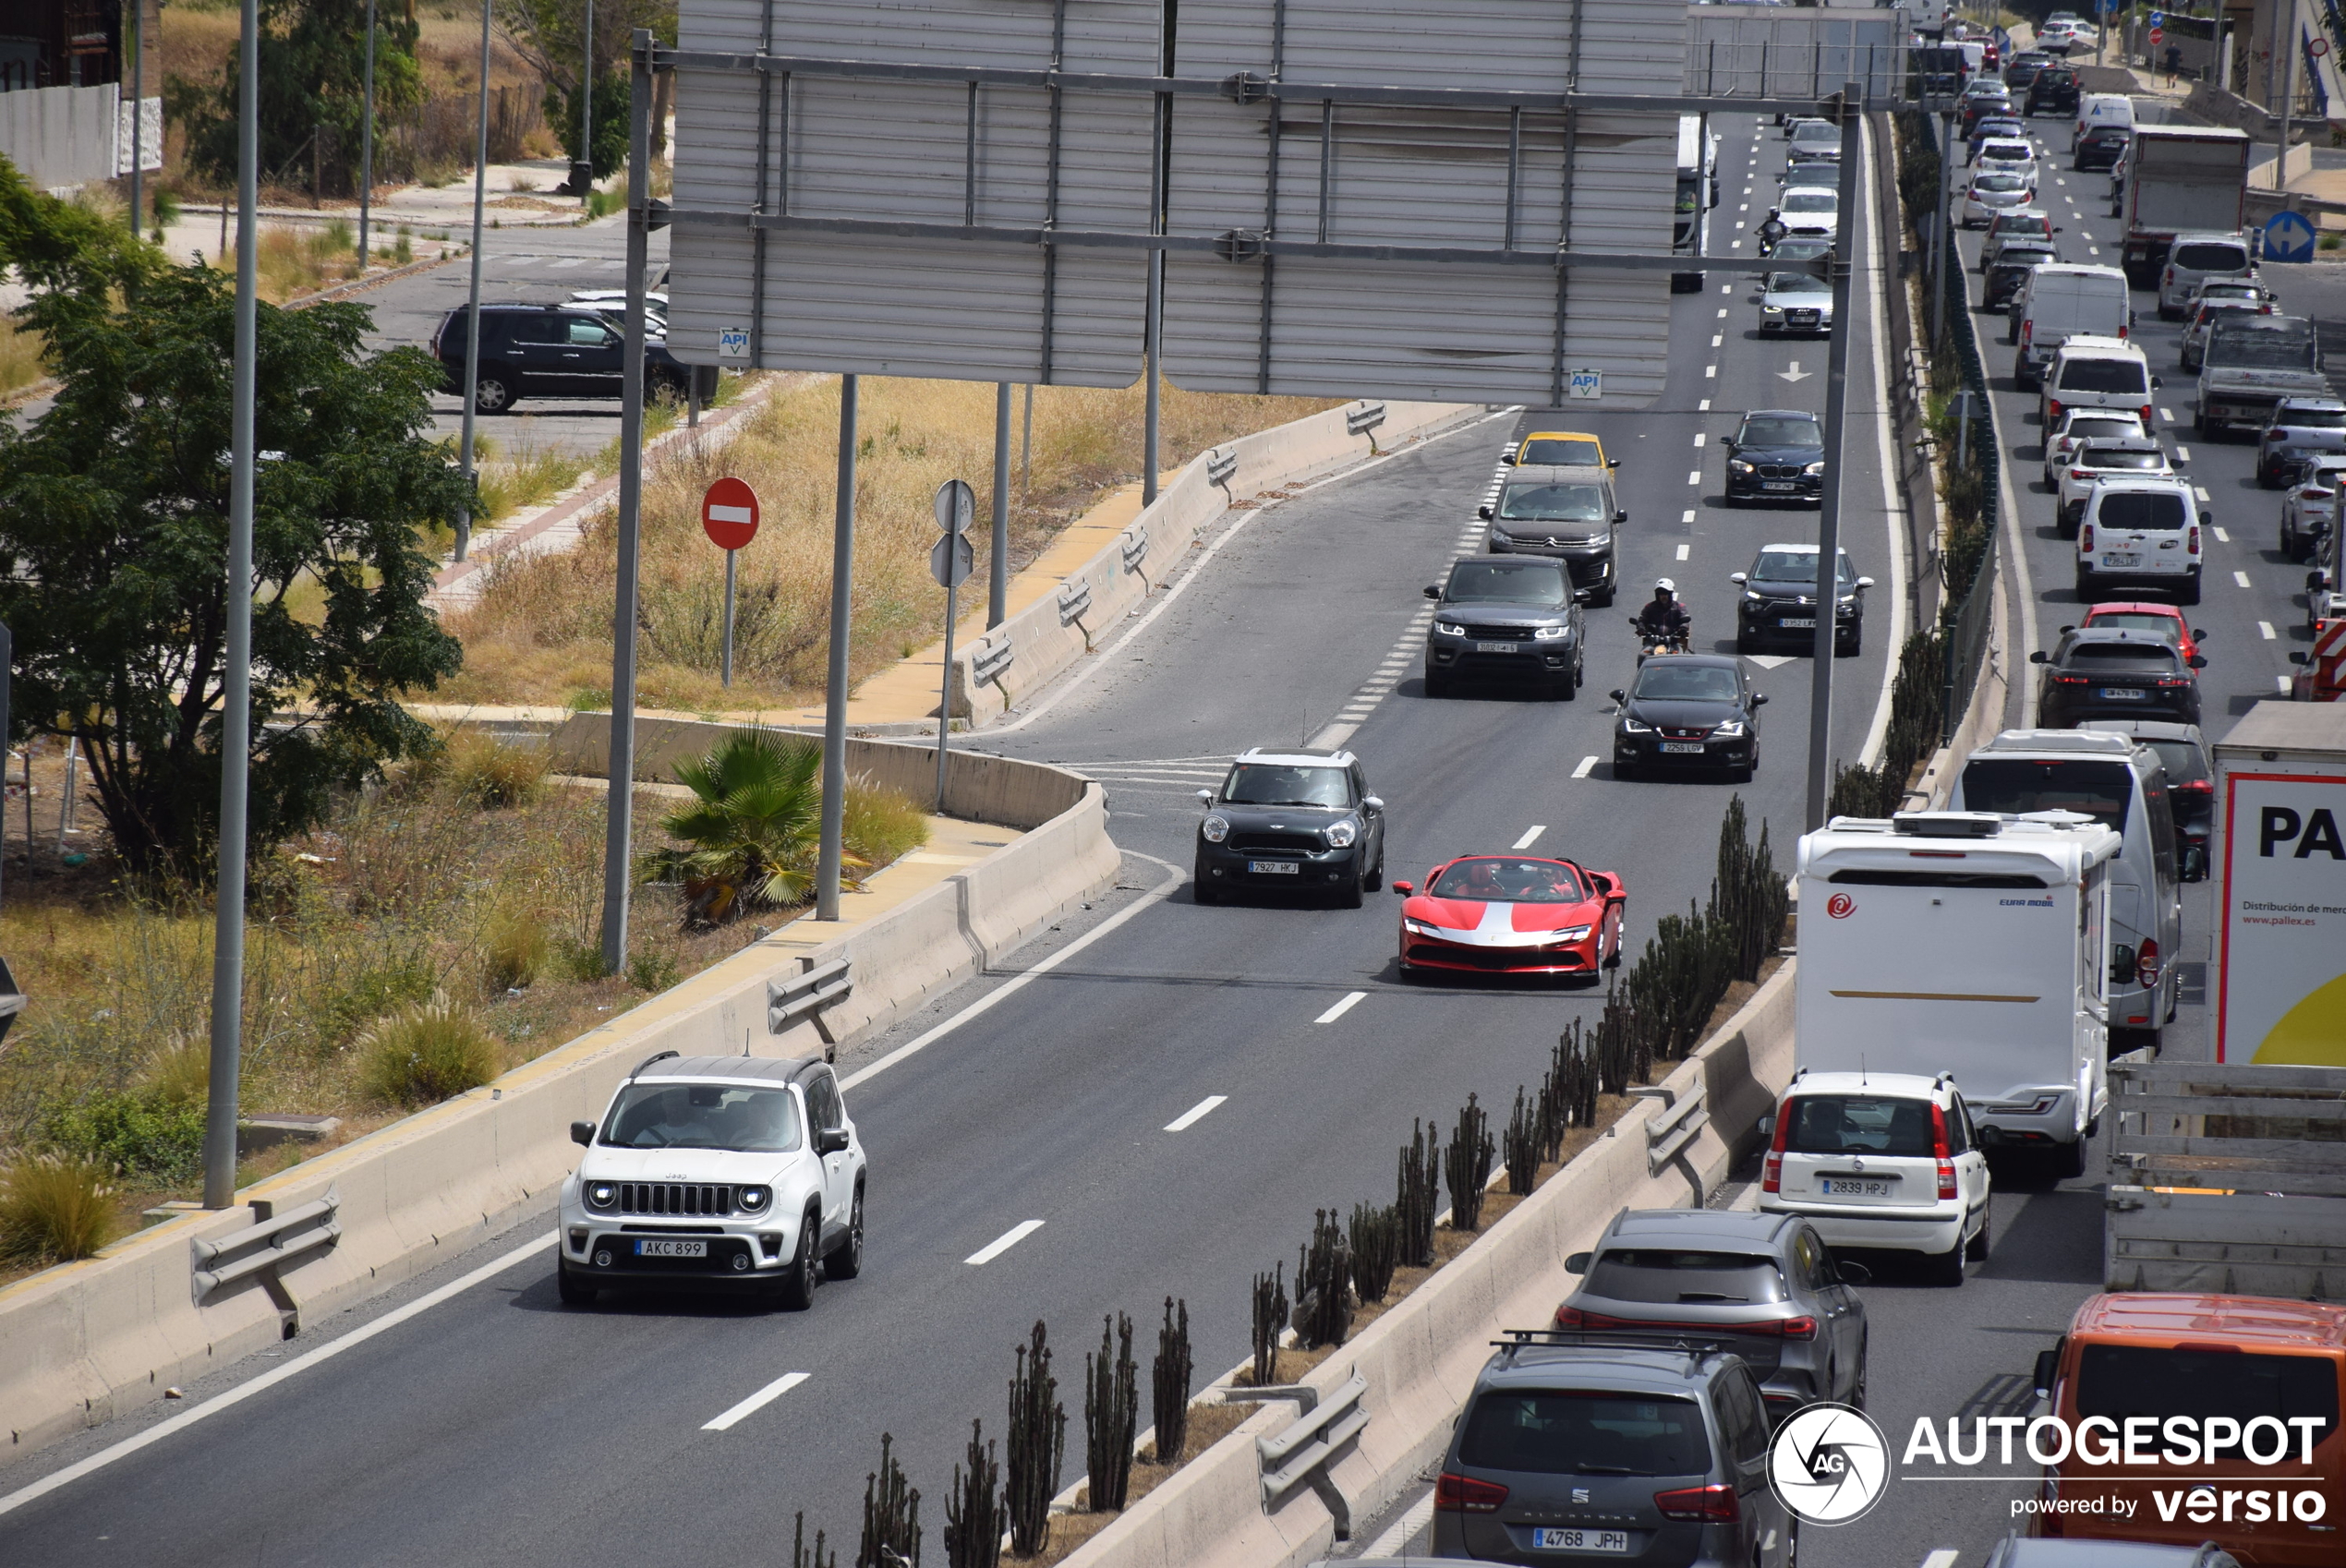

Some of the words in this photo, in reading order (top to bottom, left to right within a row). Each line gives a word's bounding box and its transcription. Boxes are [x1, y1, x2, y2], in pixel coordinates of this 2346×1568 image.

[720, 333, 747, 345] API
[1571, 375, 1598, 387] API
[2260, 806, 2346, 860] PA
[1254, 863, 1276, 872] 7927
[1280, 863, 1297, 873] HKJ
[2243, 900, 2304, 913] Distribución
[2307, 903, 2320, 913] de
[2243, 916, 2316, 927] www.pallex.es
[1832, 1182, 1862, 1193] 2839
[1866, 1183, 1888, 1195] HPJ
[646, 1242, 671, 1254] AKC
[675, 1243, 702, 1255] 899
[1545, 1531, 1583, 1546] 4768
[1594, 1533, 1624, 1549] JPH
